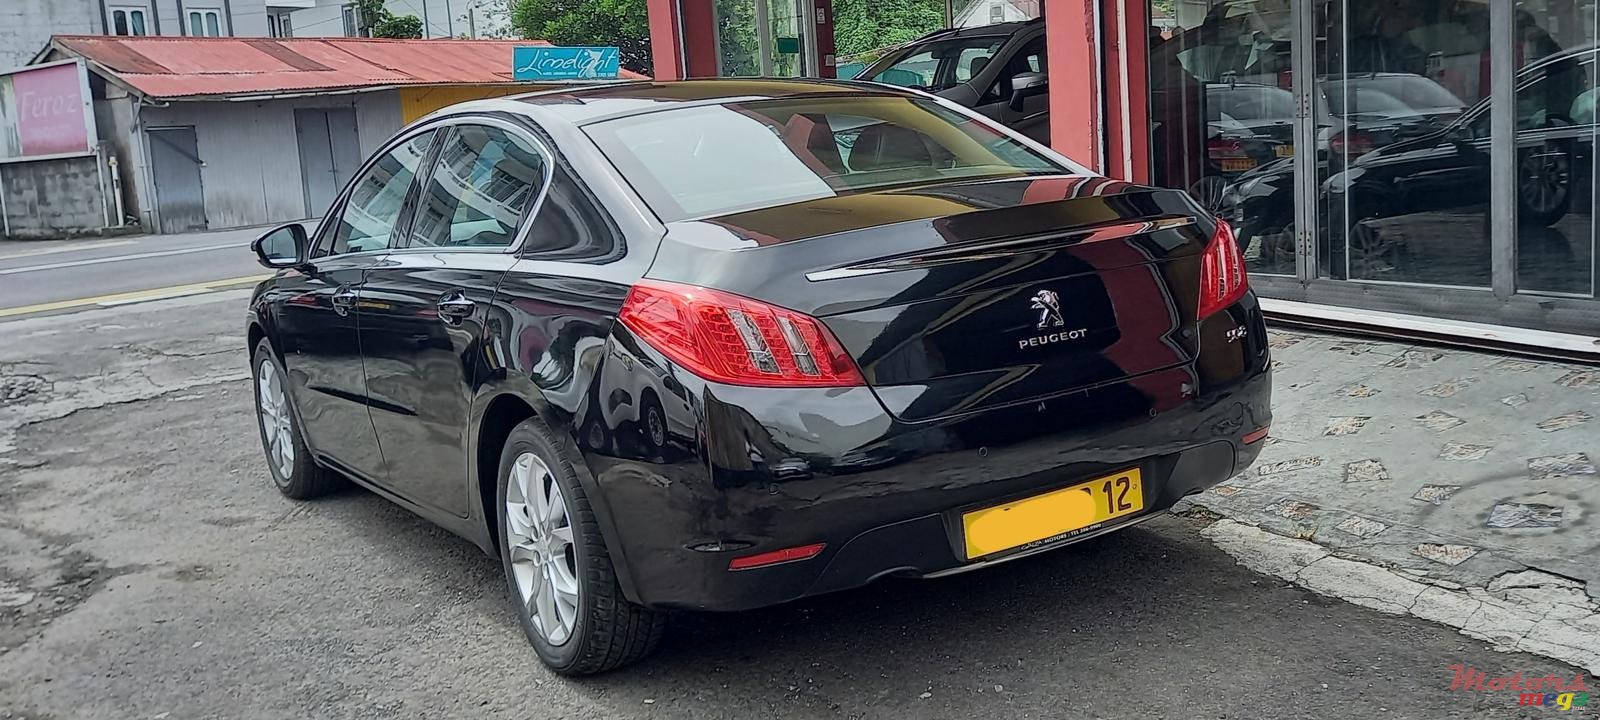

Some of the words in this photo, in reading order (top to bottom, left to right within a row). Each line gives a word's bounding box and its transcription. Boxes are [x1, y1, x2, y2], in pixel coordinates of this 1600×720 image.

[516, 48, 617, 78] Limelight
[1019, 328, 1088, 350] PEUGEOT
[1102, 476, 1132, 514] 12
[1044, 533, 1067, 543] MOTORS
